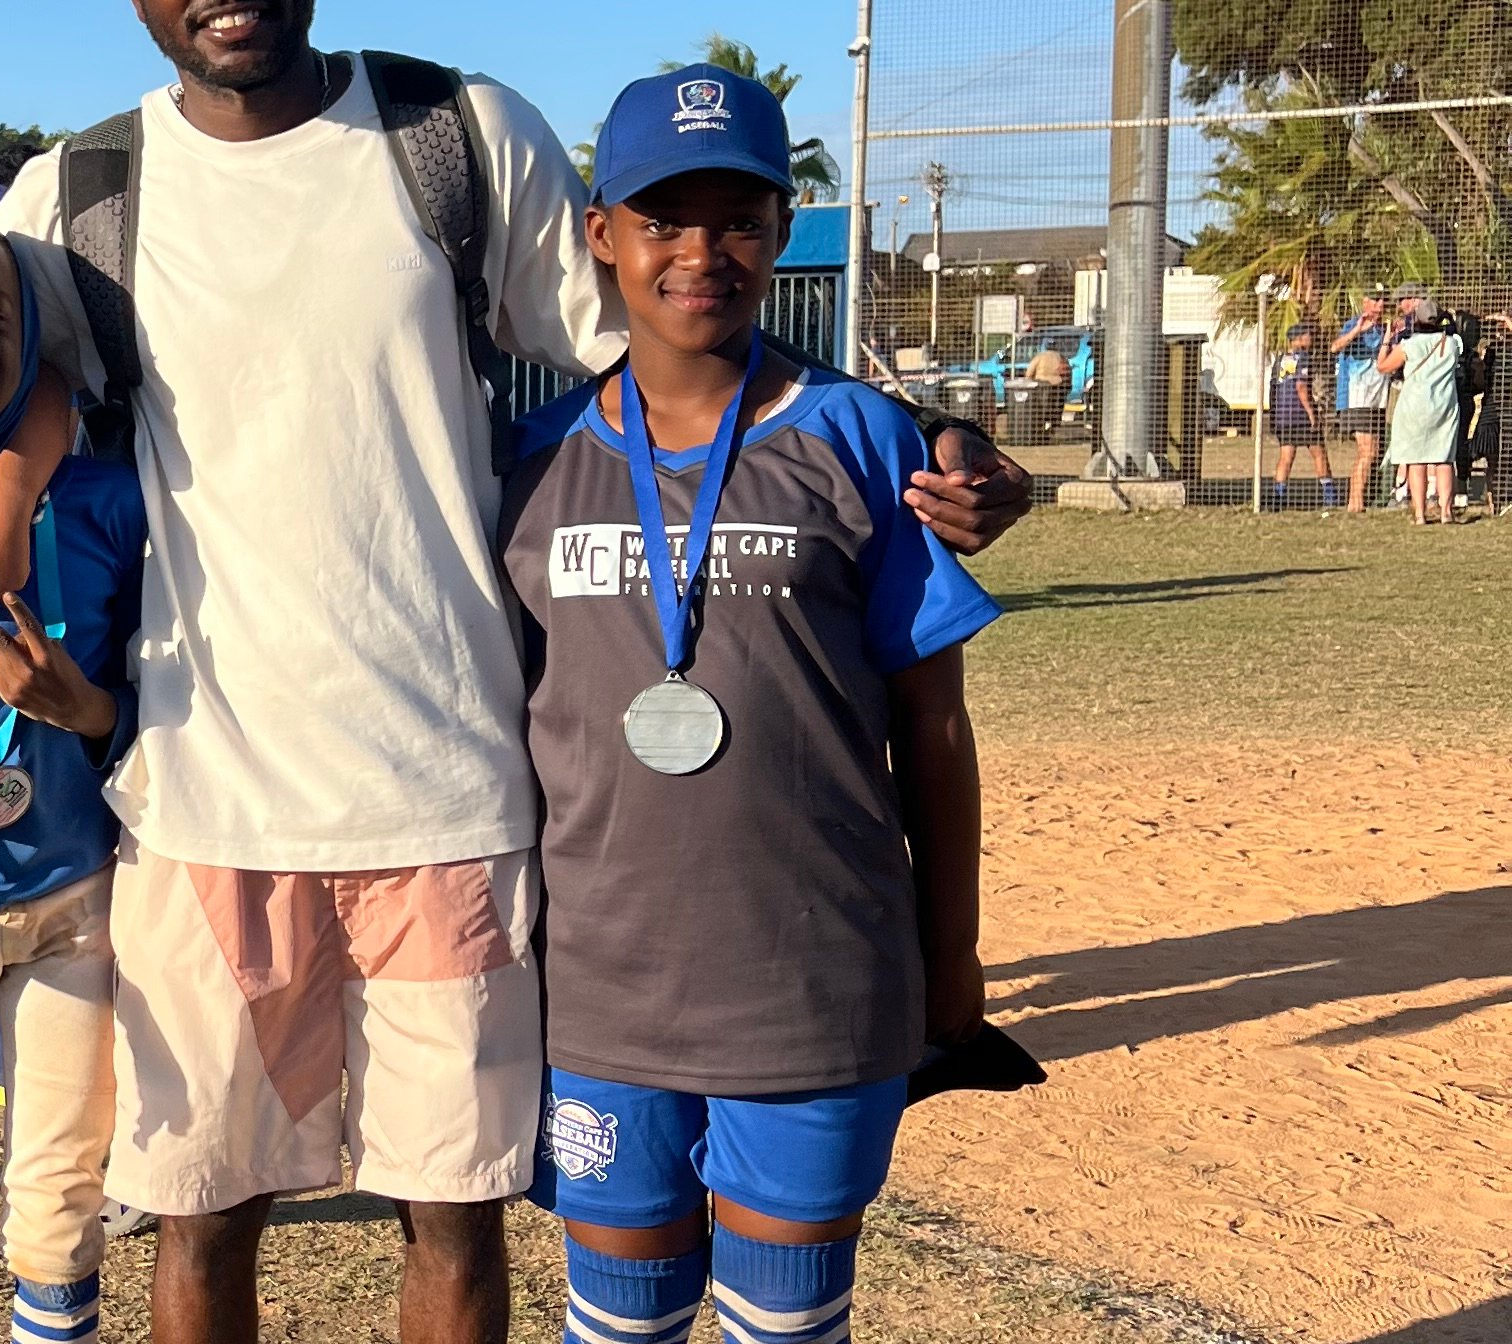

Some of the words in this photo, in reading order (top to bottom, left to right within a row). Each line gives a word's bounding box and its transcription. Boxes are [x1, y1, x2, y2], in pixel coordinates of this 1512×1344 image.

[739, 535, 796, 558] CAPE
[560, 532, 609, 586] WC
[625, 558, 732, 579] BAEBALL
[625, 583, 791, 598] FEERATION
[546, 1117, 612, 1156] BASEBALL
